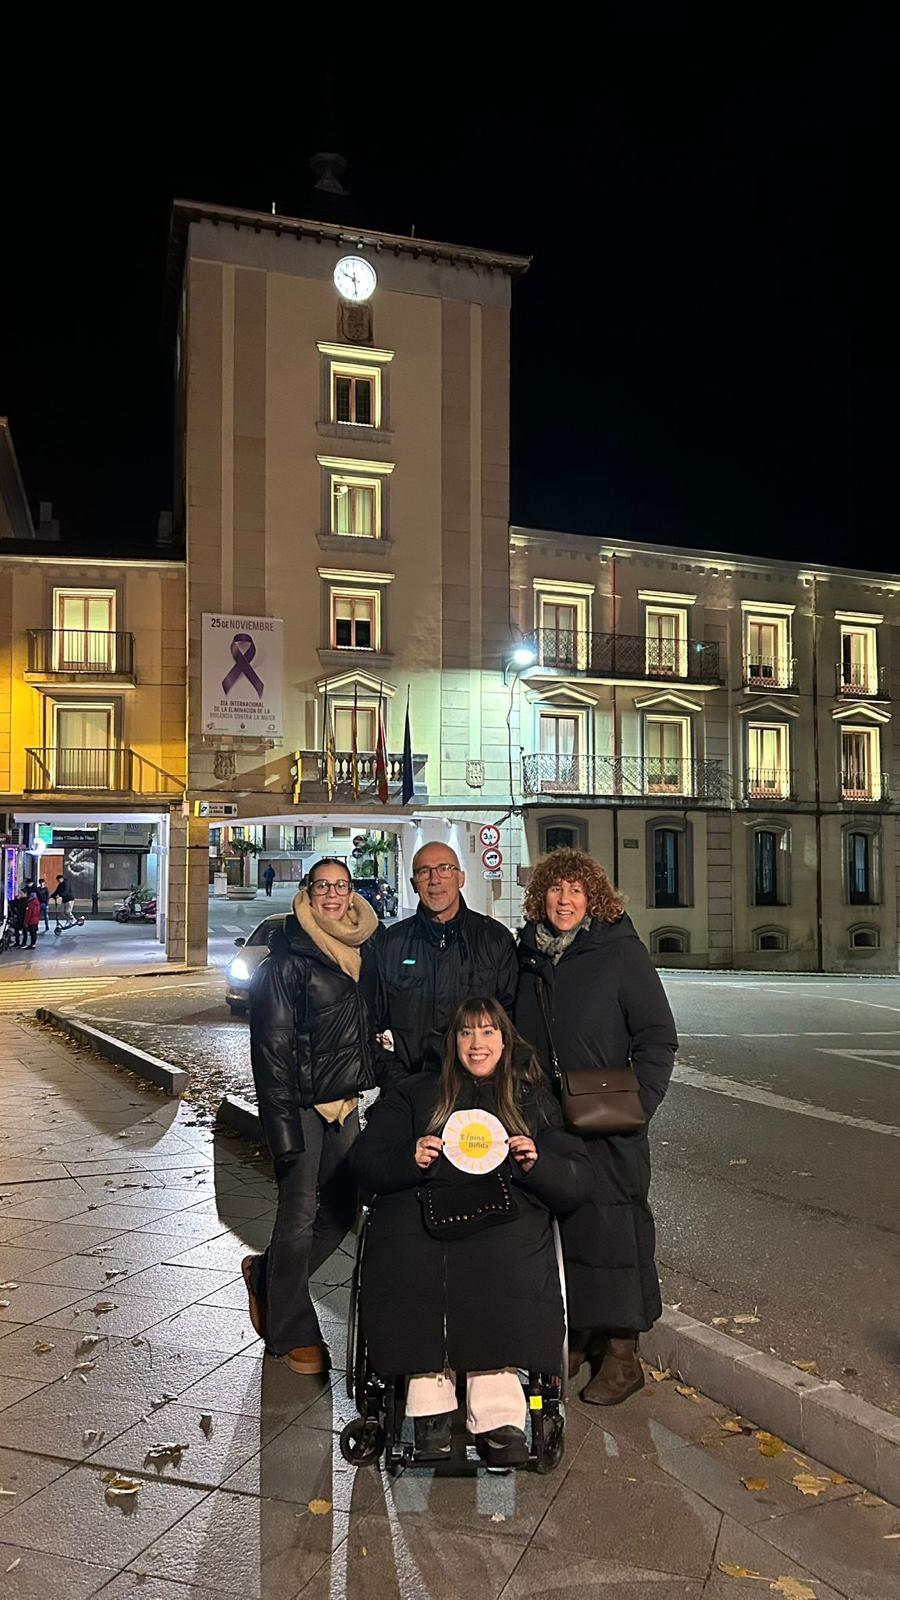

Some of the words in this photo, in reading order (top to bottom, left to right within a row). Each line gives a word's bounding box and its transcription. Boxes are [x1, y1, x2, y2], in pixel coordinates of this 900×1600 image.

[211, 618, 221, 628] 25
[221, 621, 229, 629] DE
[230, 620, 274, 632] NOVIEMBRE
